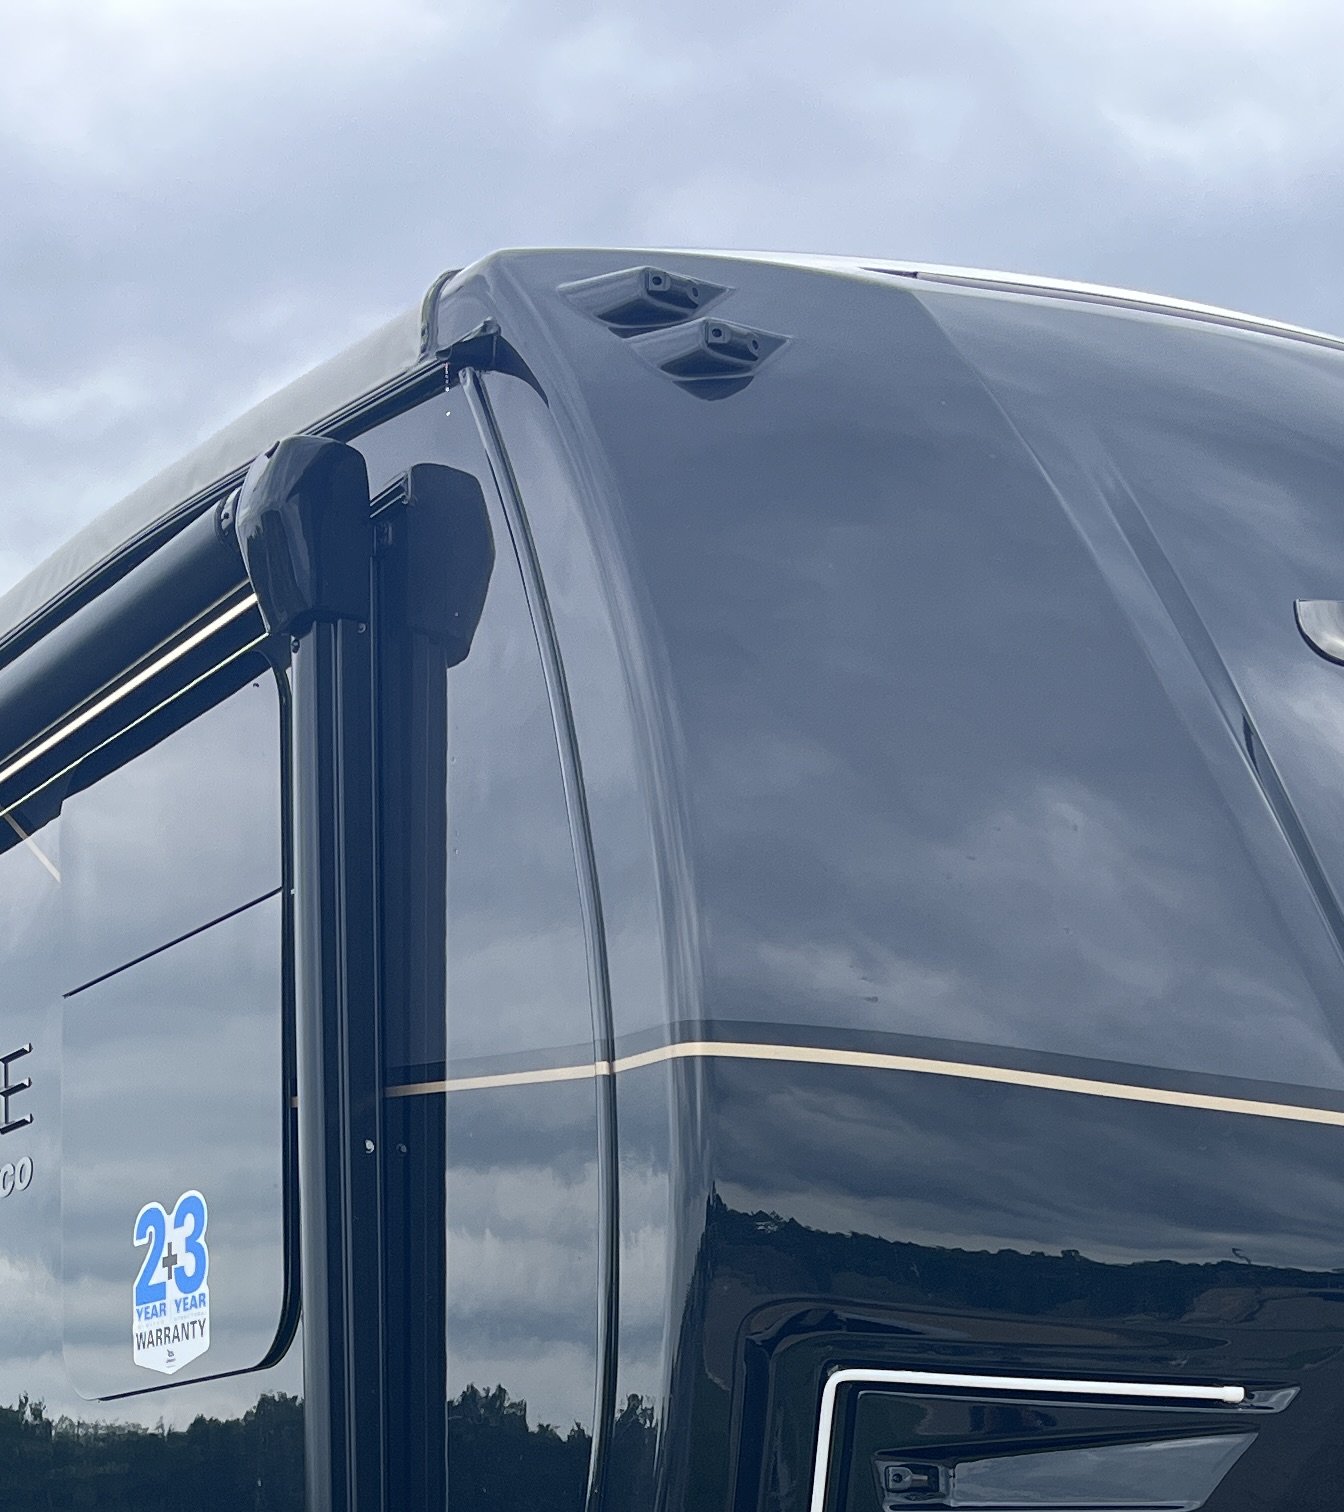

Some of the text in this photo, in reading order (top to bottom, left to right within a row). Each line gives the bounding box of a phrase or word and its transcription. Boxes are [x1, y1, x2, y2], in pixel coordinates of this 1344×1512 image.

[136, 1292, 207, 1322] YEAR YEAR
[136, 1317, 207, 1351] WARRANTY
